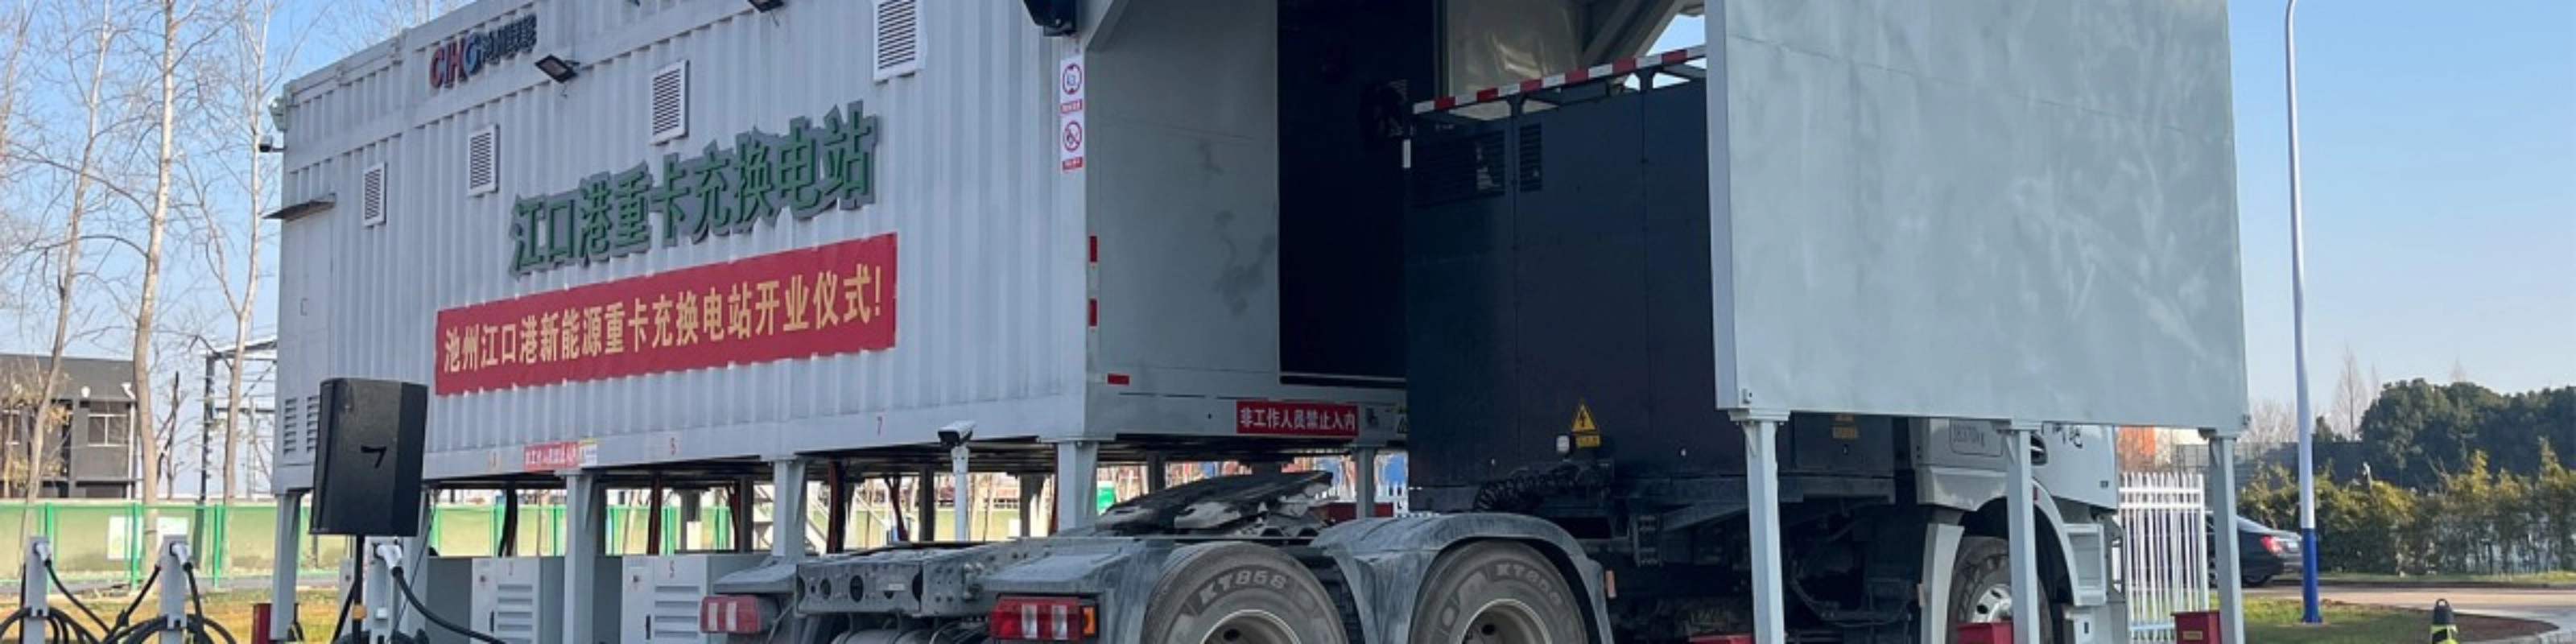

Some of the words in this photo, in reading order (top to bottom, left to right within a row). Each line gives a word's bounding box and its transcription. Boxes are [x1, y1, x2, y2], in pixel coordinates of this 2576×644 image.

[512, 104, 877, 272] 江口港重卡充换电站
[444, 262, 881, 374] 池州江口港新能源重卡充换电站开业仪式!
[1240, 407, 1356, 431] 非工作人员禁止入内
